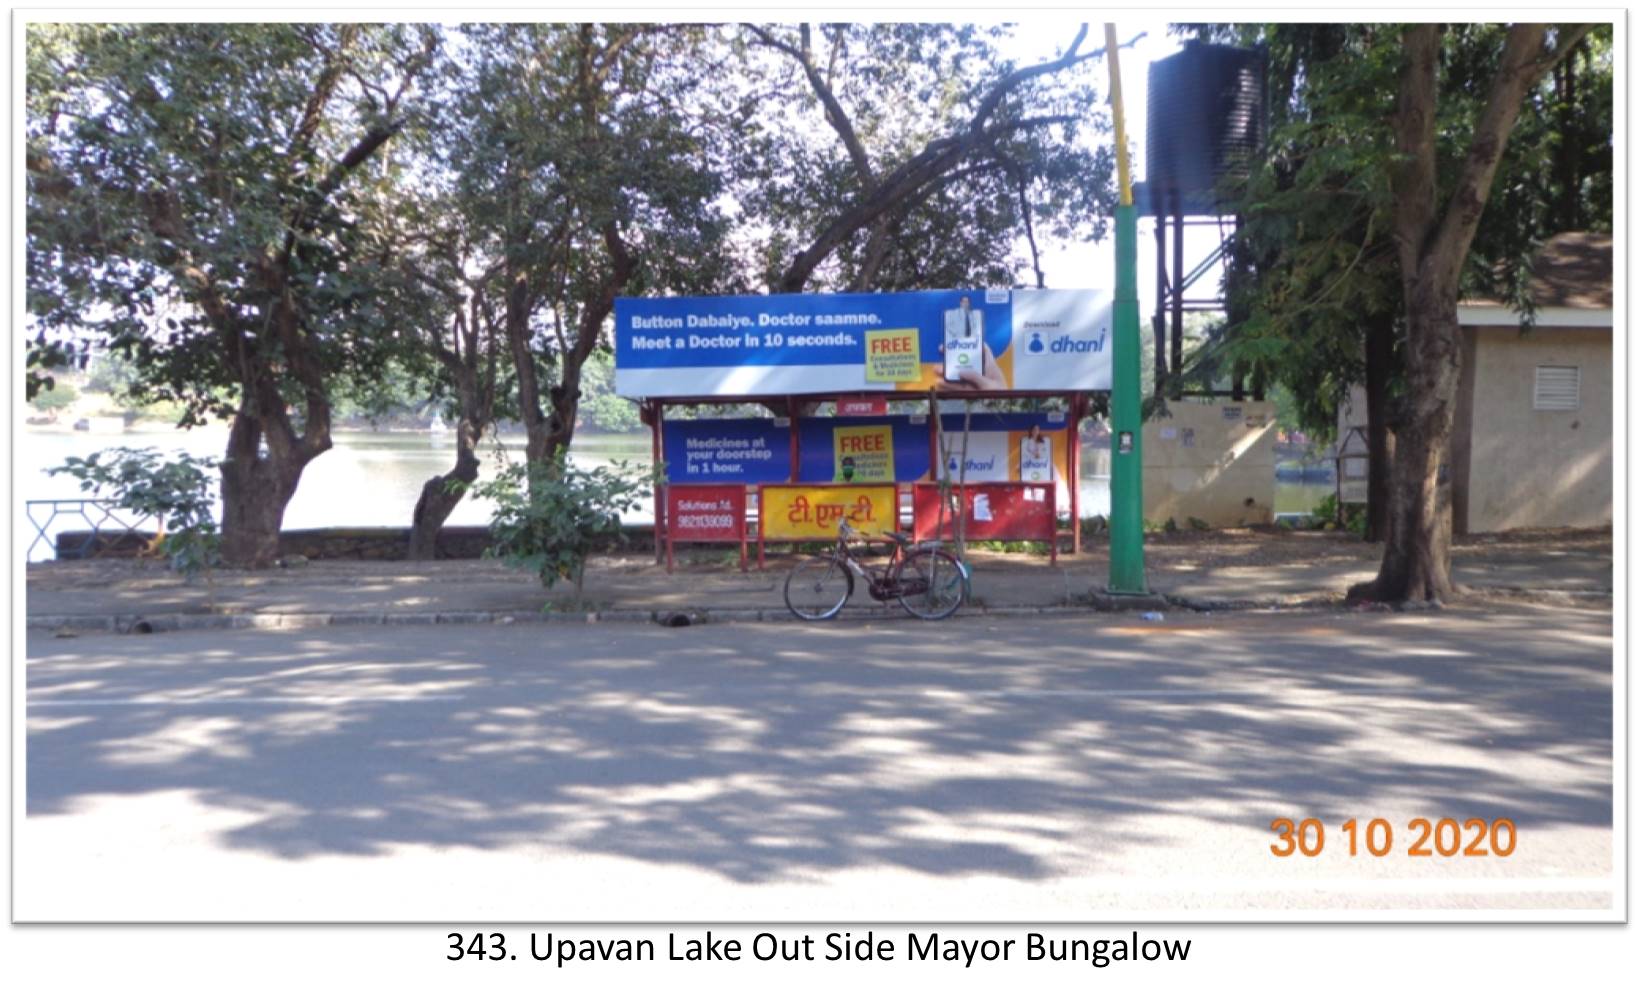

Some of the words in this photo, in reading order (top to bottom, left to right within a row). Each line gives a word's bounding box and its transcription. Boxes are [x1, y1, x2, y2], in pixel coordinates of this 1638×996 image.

[631, 315, 683, 329] Button
[687, 314, 754, 331] Dabaiye.
[758, 312, 811, 327] Doctor
[815, 313, 882, 325] saamne.
[631, 335, 671, 349] Meet
[675, 338, 685, 349] a
[689, 334, 741, 348] Doctor
[745, 333, 759, 348] in
[764, 332, 783, 347] 10
[787, 332, 857, 347] seconds.
[871, 336, 912, 354] FREE
[947, 335, 979, 350] dhani
[1051, 328, 1106, 353] dhani
[686, 437, 748, 449] Medicines
[752, 436, 765, 448] at
[840, 433, 885, 453] FREE
[686, 450, 713, 463] your
[716, 448, 772, 462] doorstep
[686, 462, 699, 473] in
[702, 462, 710, 473] 1
[713, 461, 744, 473] hour.
[1023, 458, 1048, 470] dhani
